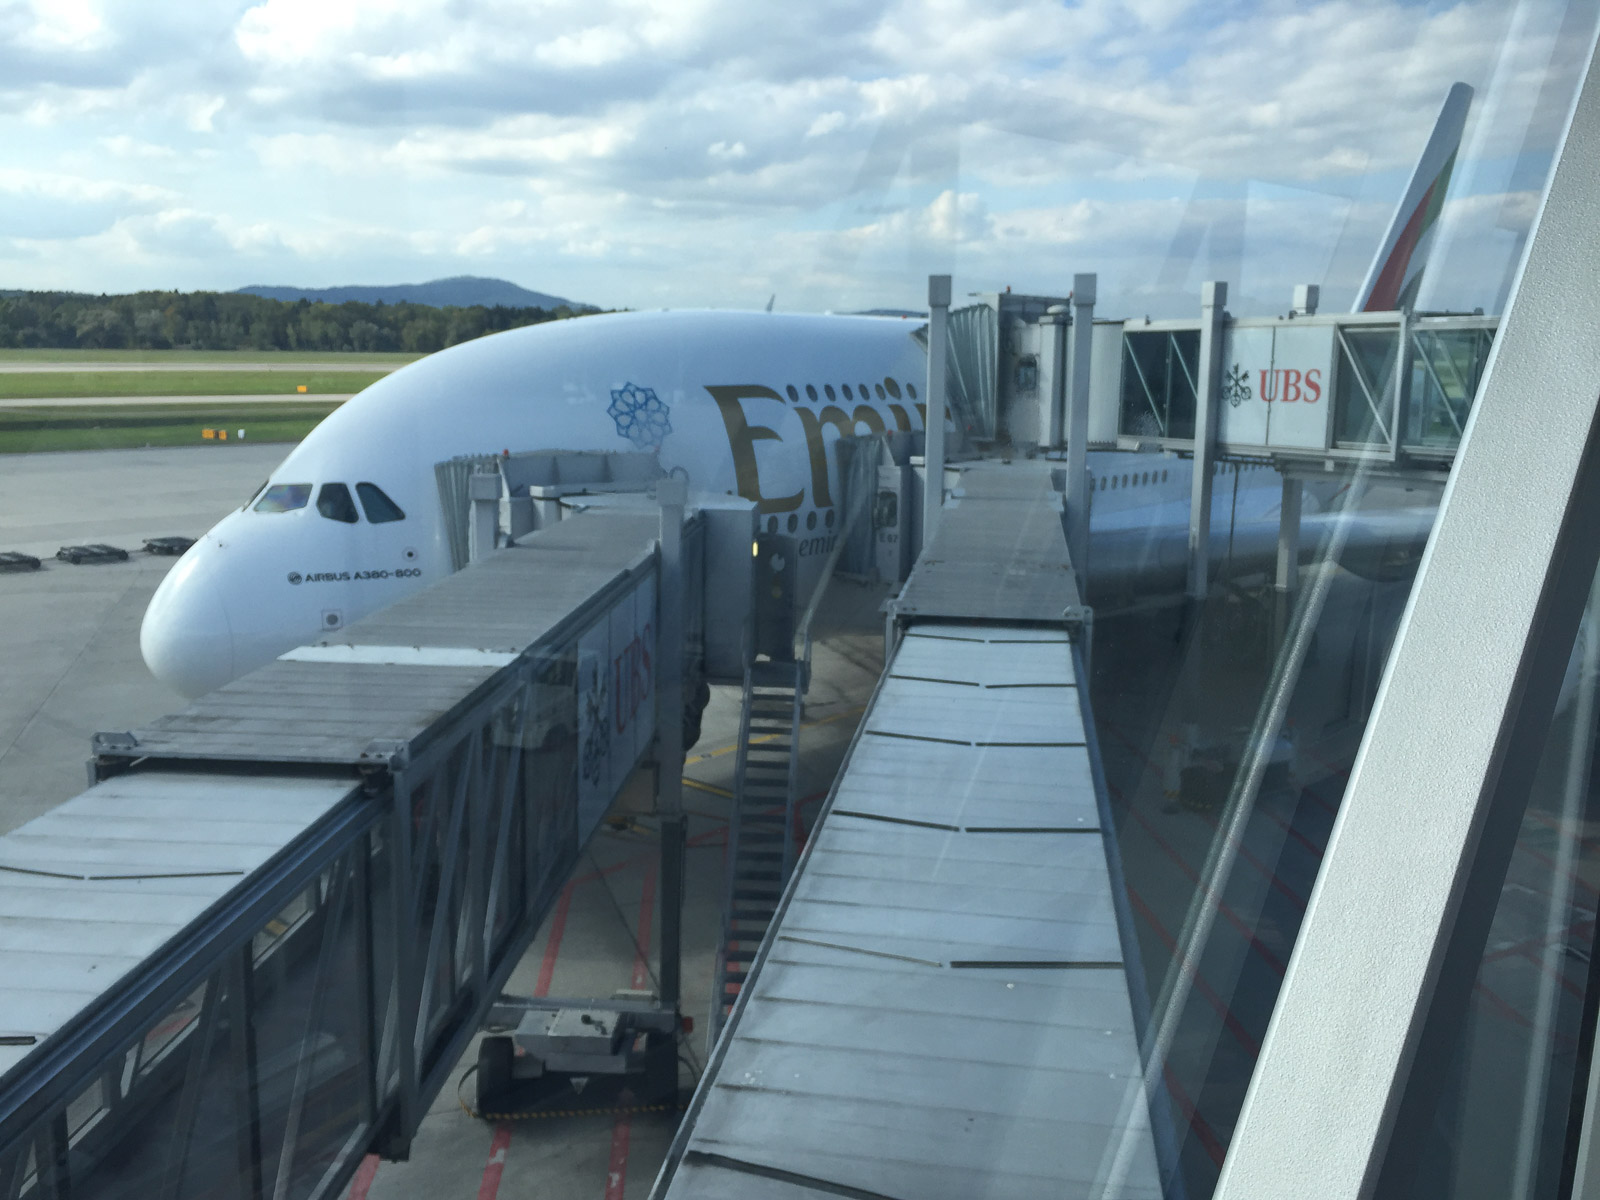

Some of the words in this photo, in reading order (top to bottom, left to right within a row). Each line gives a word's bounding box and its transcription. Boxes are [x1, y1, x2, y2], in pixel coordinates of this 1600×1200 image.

[1259, 368, 1322, 403] UBS
[703, 377, 952, 515] Em
[305, 571, 351, 583] AIRBUS
[354, 567, 422, 580] A380-800
[613, 623, 650, 734] UBS
